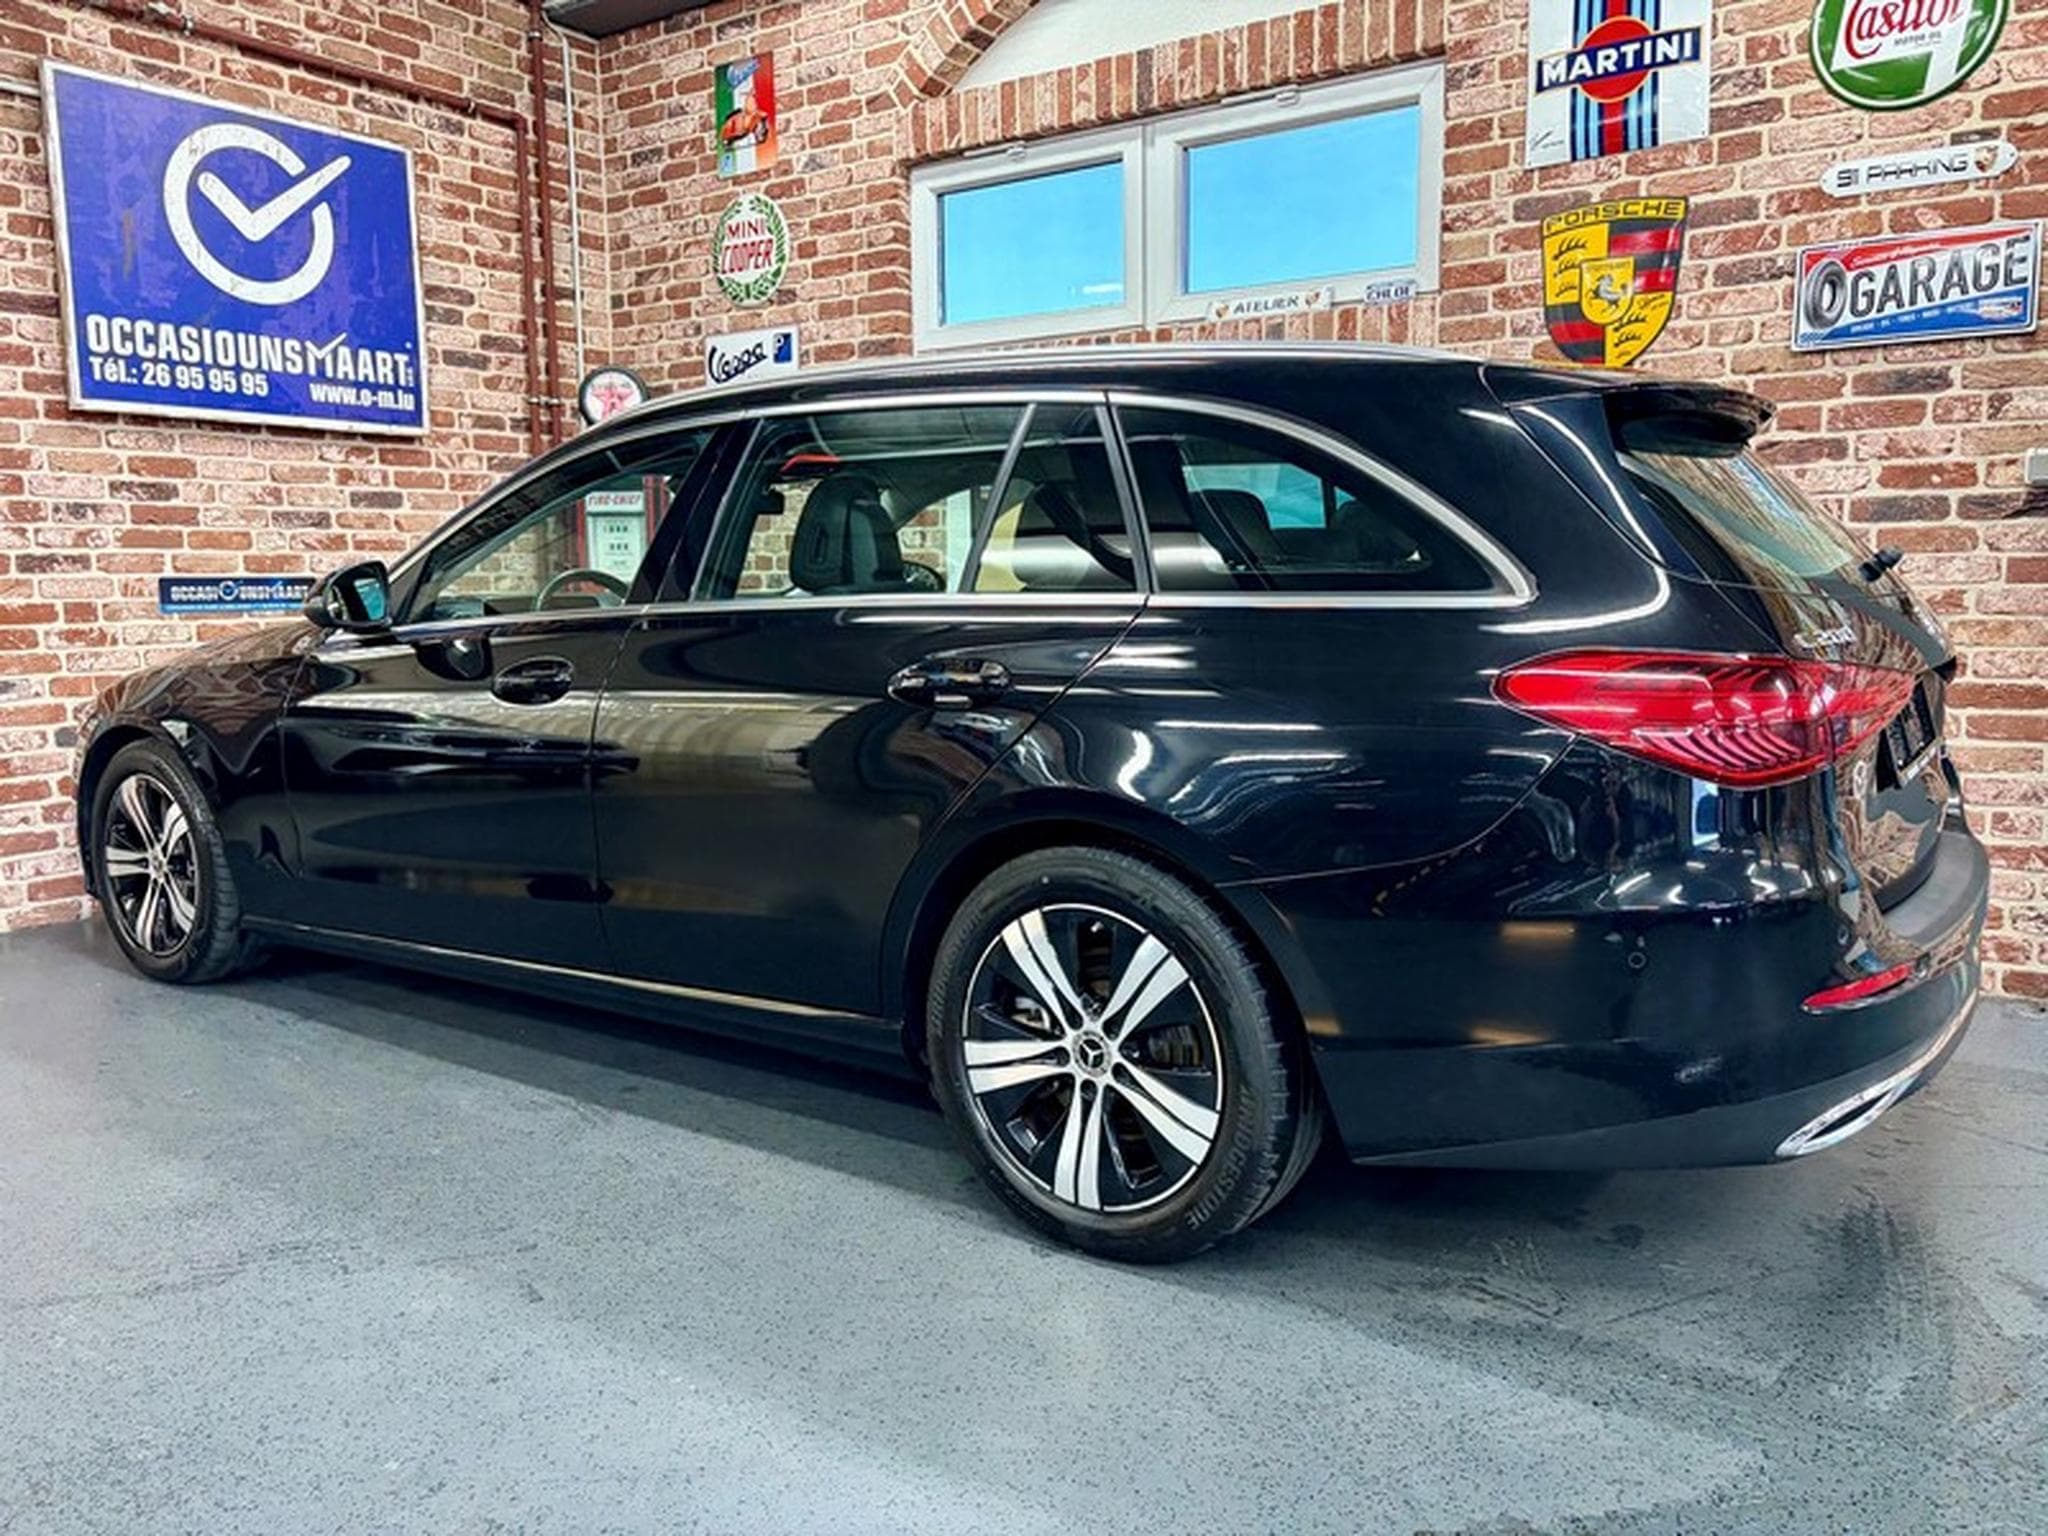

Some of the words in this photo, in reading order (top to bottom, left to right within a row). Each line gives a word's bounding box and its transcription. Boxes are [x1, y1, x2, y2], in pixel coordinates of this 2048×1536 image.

[1541, 32, 1694, 88] MARTINI
[1866, 153, 1968, 185] PARKING
[728, 219, 767, 239] MINI
[1546, 201, 1683, 233] PORSCHE
[721, 239, 774, 274] COOPER
[1850, 235, 2030, 317] GARAGE
[1233, 295, 1299, 315] ATELIER
[85, 313, 410, 388] OCCASIOUNSMAART
[708, 341, 769, 384] Vespa
[141, 361, 171, 388] 26
[174, 364, 205, 391] 95
[208, 367, 238, 394] 95
[240, 371, 269, 397] 95
[309, 382, 415, 411] www.o-m.lu
